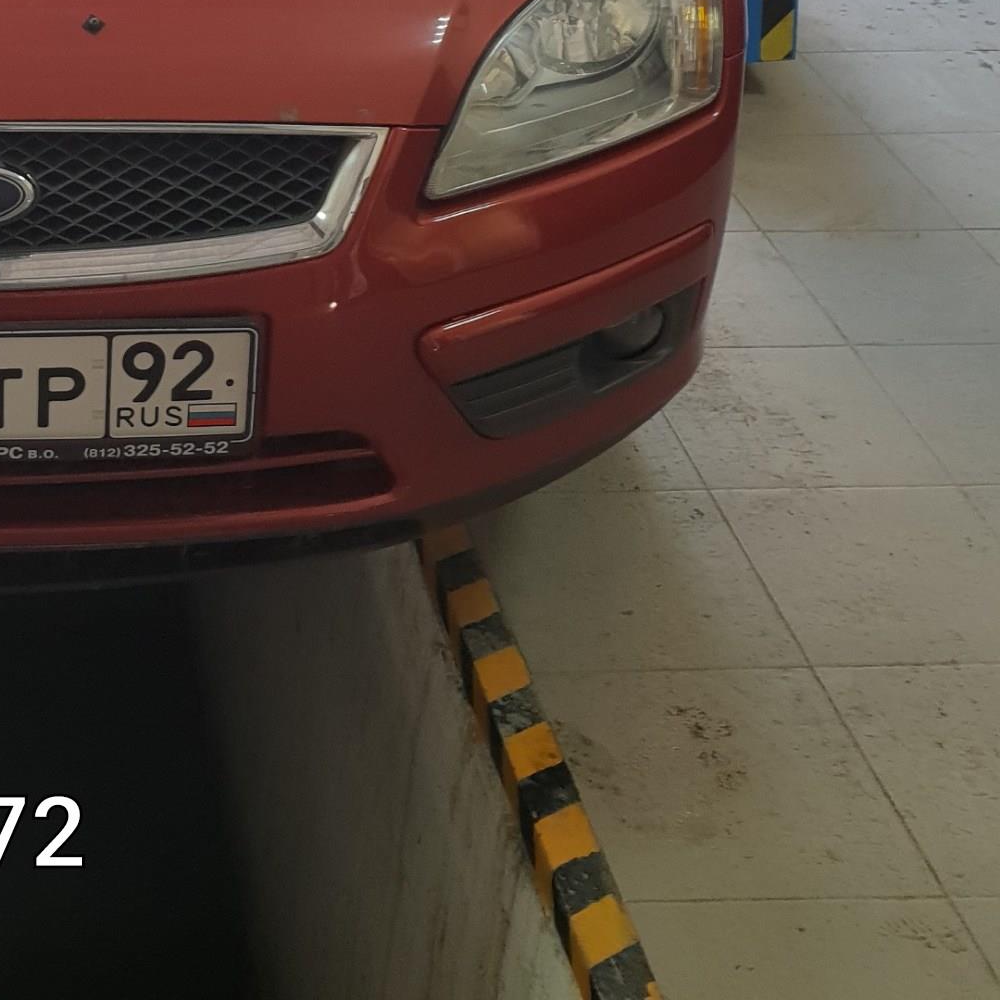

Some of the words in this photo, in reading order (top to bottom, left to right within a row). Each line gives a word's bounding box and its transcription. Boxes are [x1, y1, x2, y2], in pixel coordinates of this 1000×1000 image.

[122, 341, 216, 403] 92
[116, 405, 183, 428] RUS
[83, 447, 121, 459] (812)
[123, 441, 229, 457] 325-52-52
